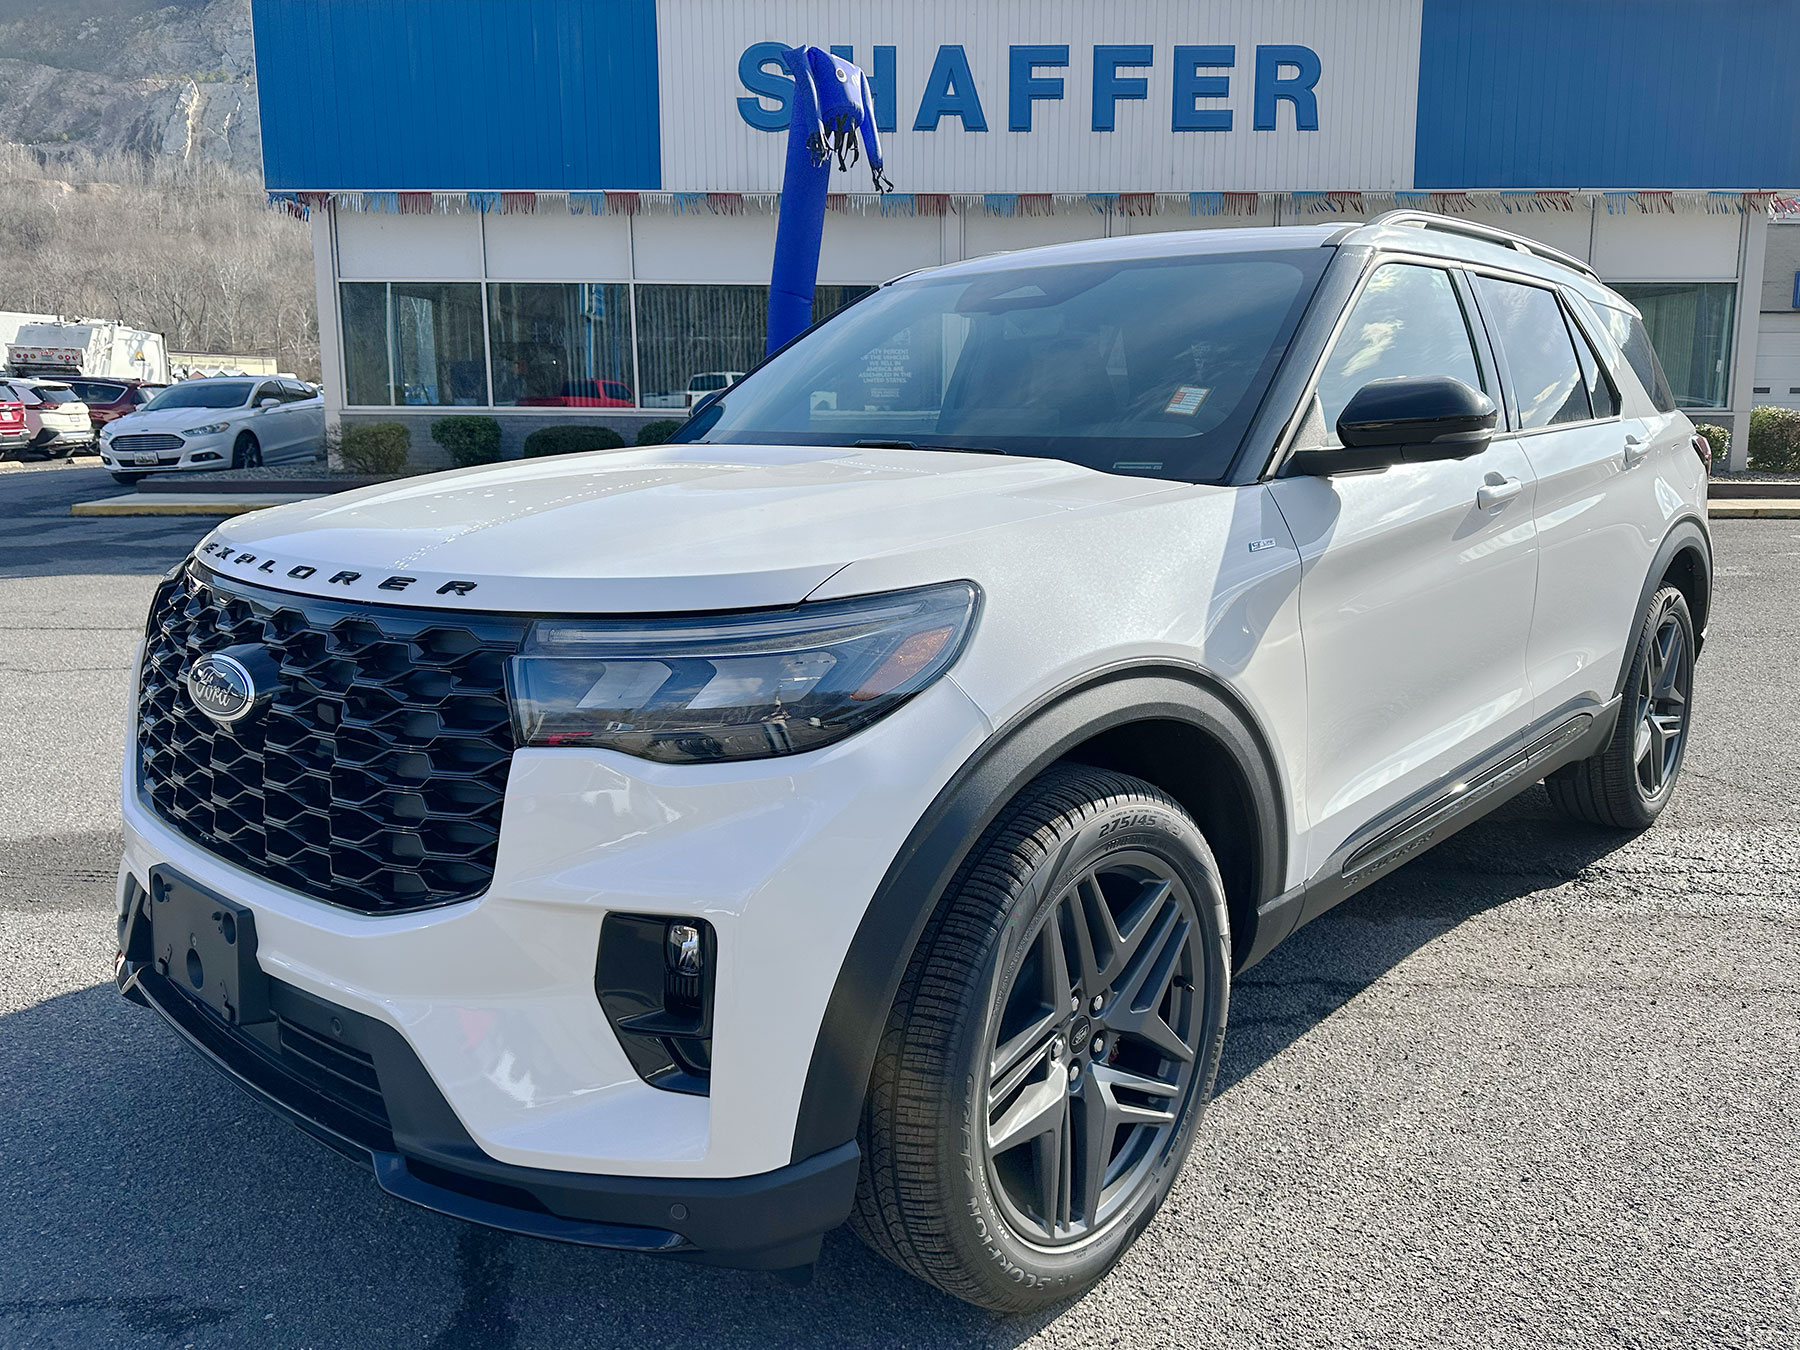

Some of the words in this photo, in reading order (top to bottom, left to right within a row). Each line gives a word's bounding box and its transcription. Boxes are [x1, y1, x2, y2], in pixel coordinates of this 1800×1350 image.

[736, 41, 1322, 133] SHAFFER
[202, 541, 478, 597] EXPLORER
[195, 666, 231, 707] Ford
[1099, 815, 1158, 838] 275/45
